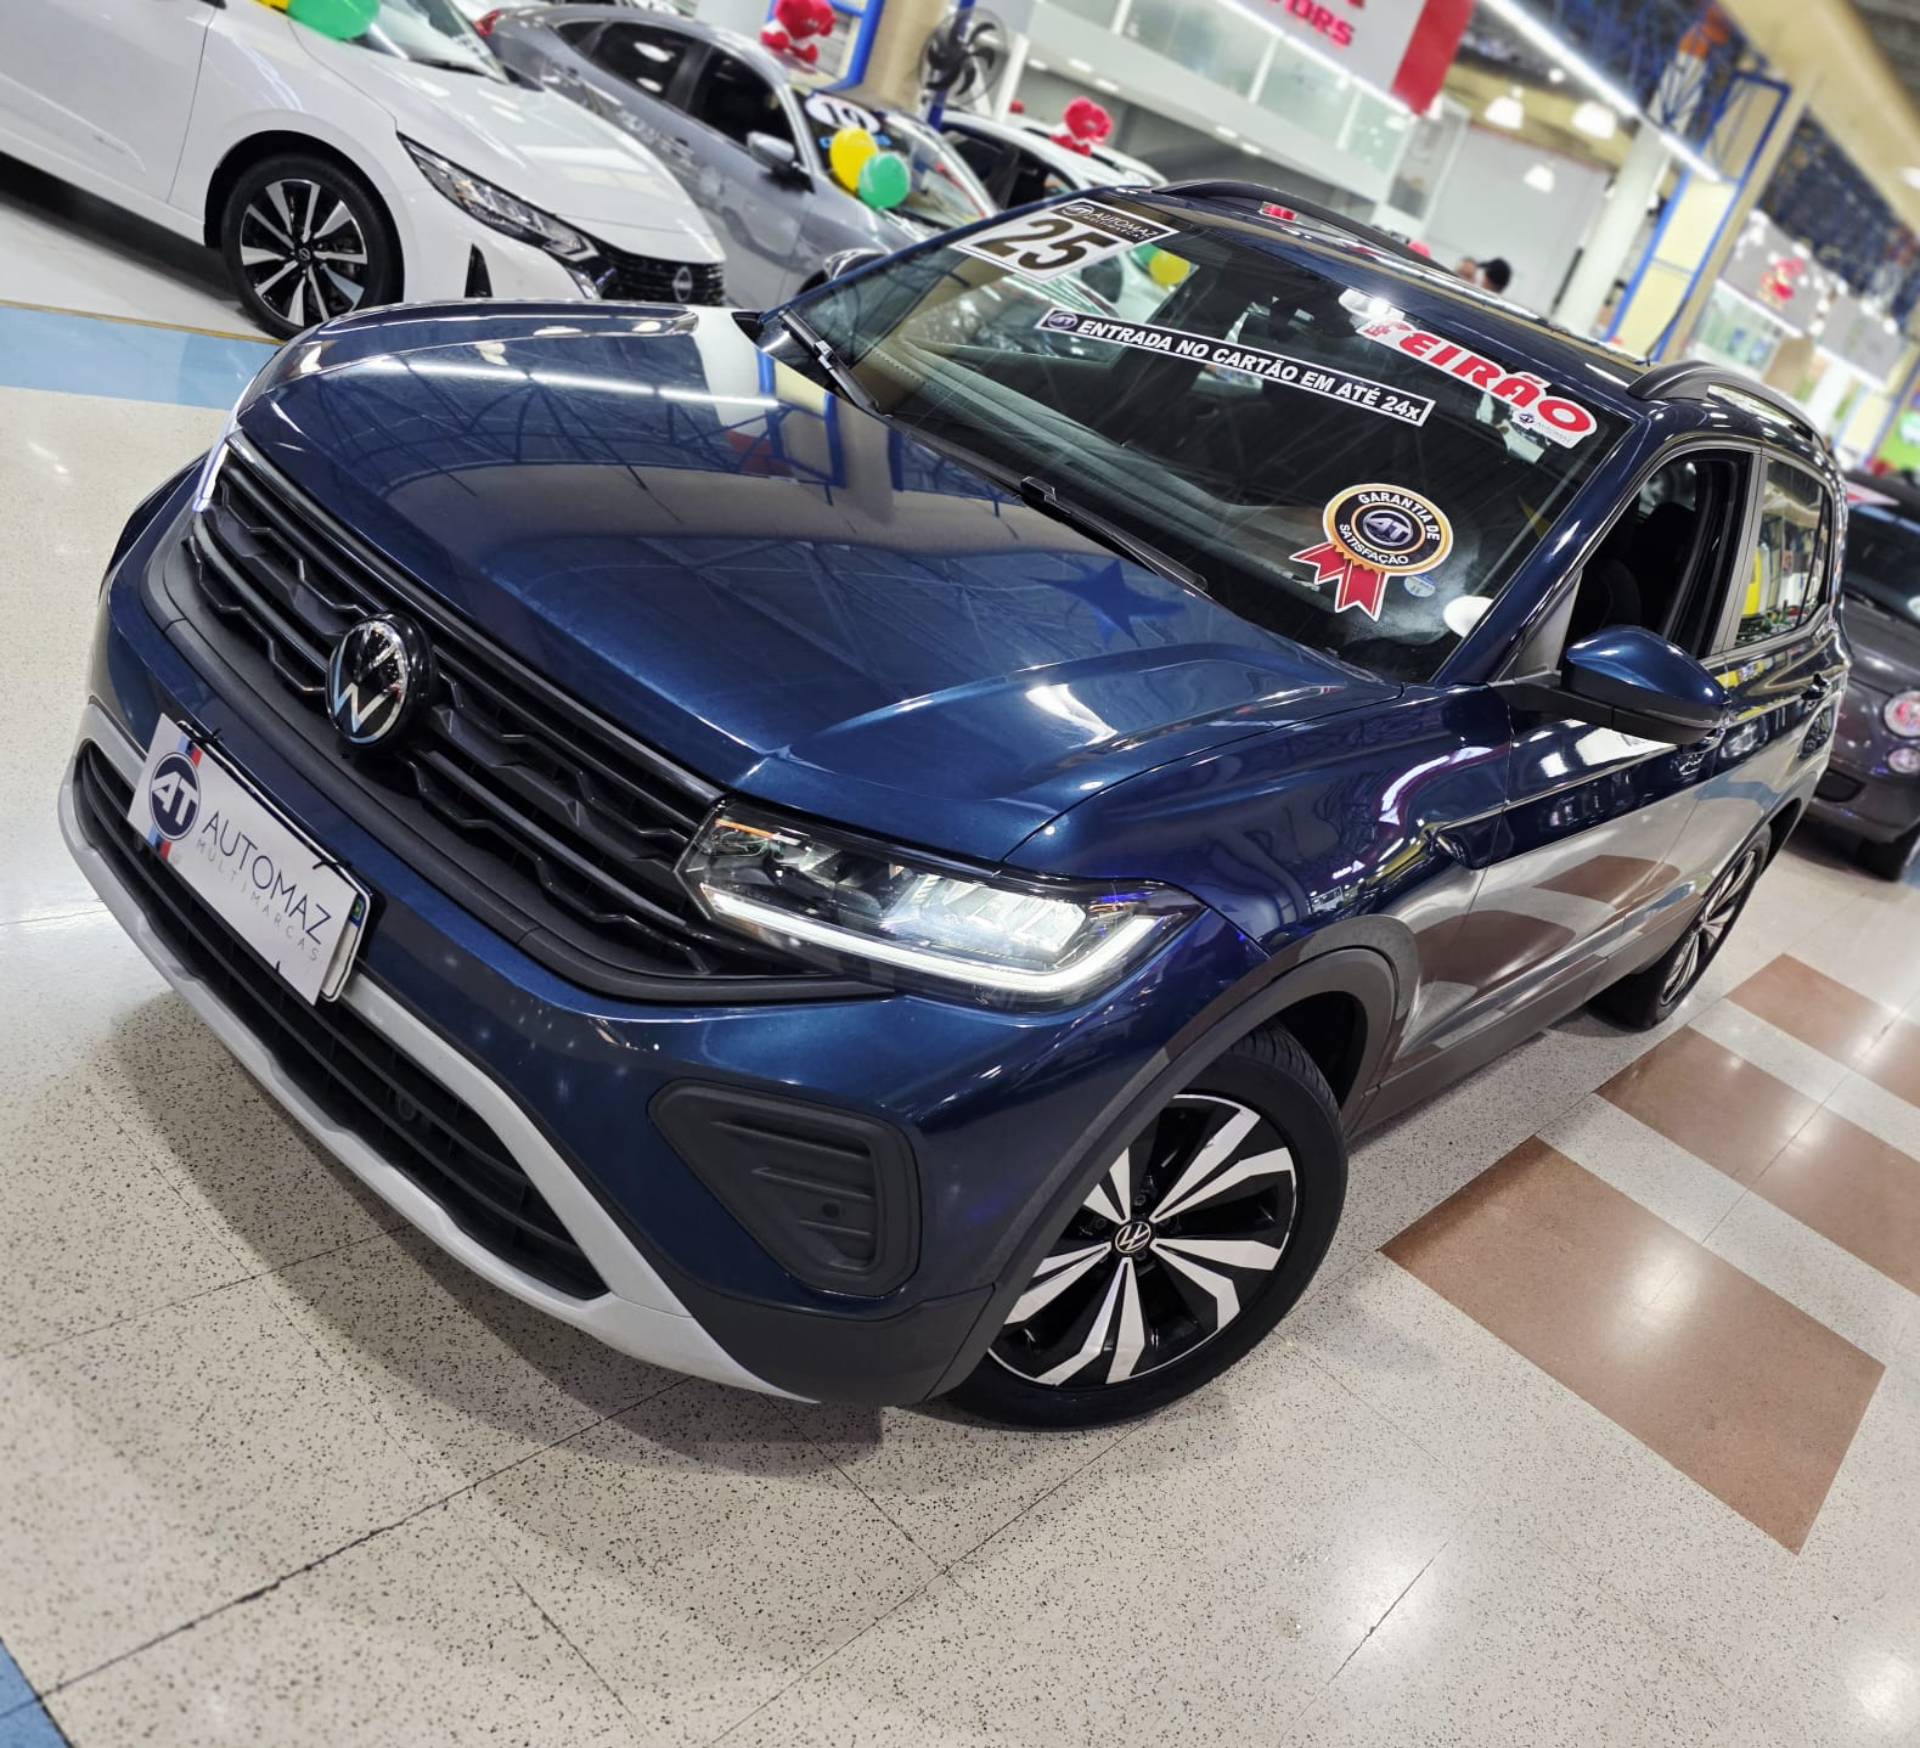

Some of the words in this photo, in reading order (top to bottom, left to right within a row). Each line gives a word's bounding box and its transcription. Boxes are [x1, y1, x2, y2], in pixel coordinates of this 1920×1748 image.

[1269, 0, 1355, 47] ORS
[972, 219, 1119, 270] 25
[1077, 320, 1172, 351] ENTRADA
[1175, 340, 1210, 358] NO
[1212, 348, 1298, 381] CARTÃO
[1301, 370, 1336, 392] EM
[1335, 382, 1381, 406] ATÉ
[1380, 395, 1422, 421] 24x
[1358, 491, 1433, 523] GARANTIA
[1425, 524, 1440, 541] DE
[1339, 523, 1409, 565] SATISFAÇÃO
[198, 838, 319, 962] MULTIMARCAS
[202, 810, 332, 946] AUTOMAZ
